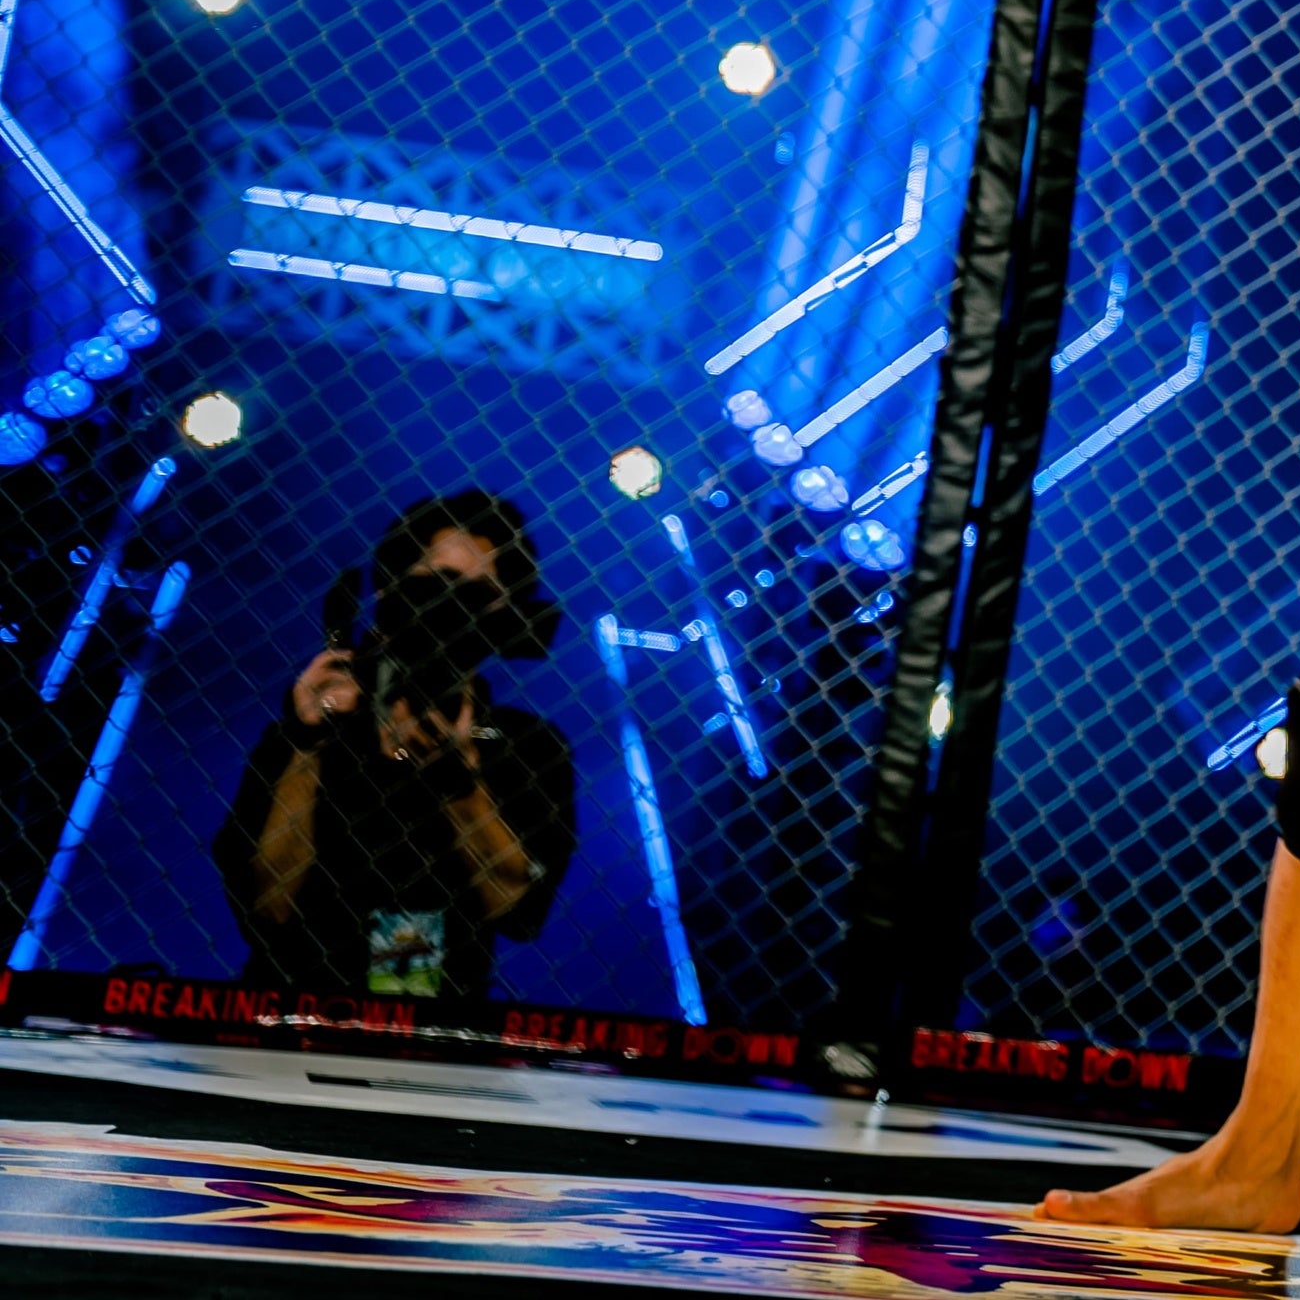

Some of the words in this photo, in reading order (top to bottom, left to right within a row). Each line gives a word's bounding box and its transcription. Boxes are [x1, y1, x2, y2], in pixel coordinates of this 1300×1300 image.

[102, 977, 281, 1023] BREAKING
[503, 1008, 669, 1058] BREAKING
[910, 1026, 1070, 1082] BREAKING
[1080, 1045, 1191, 1092] DOWN
